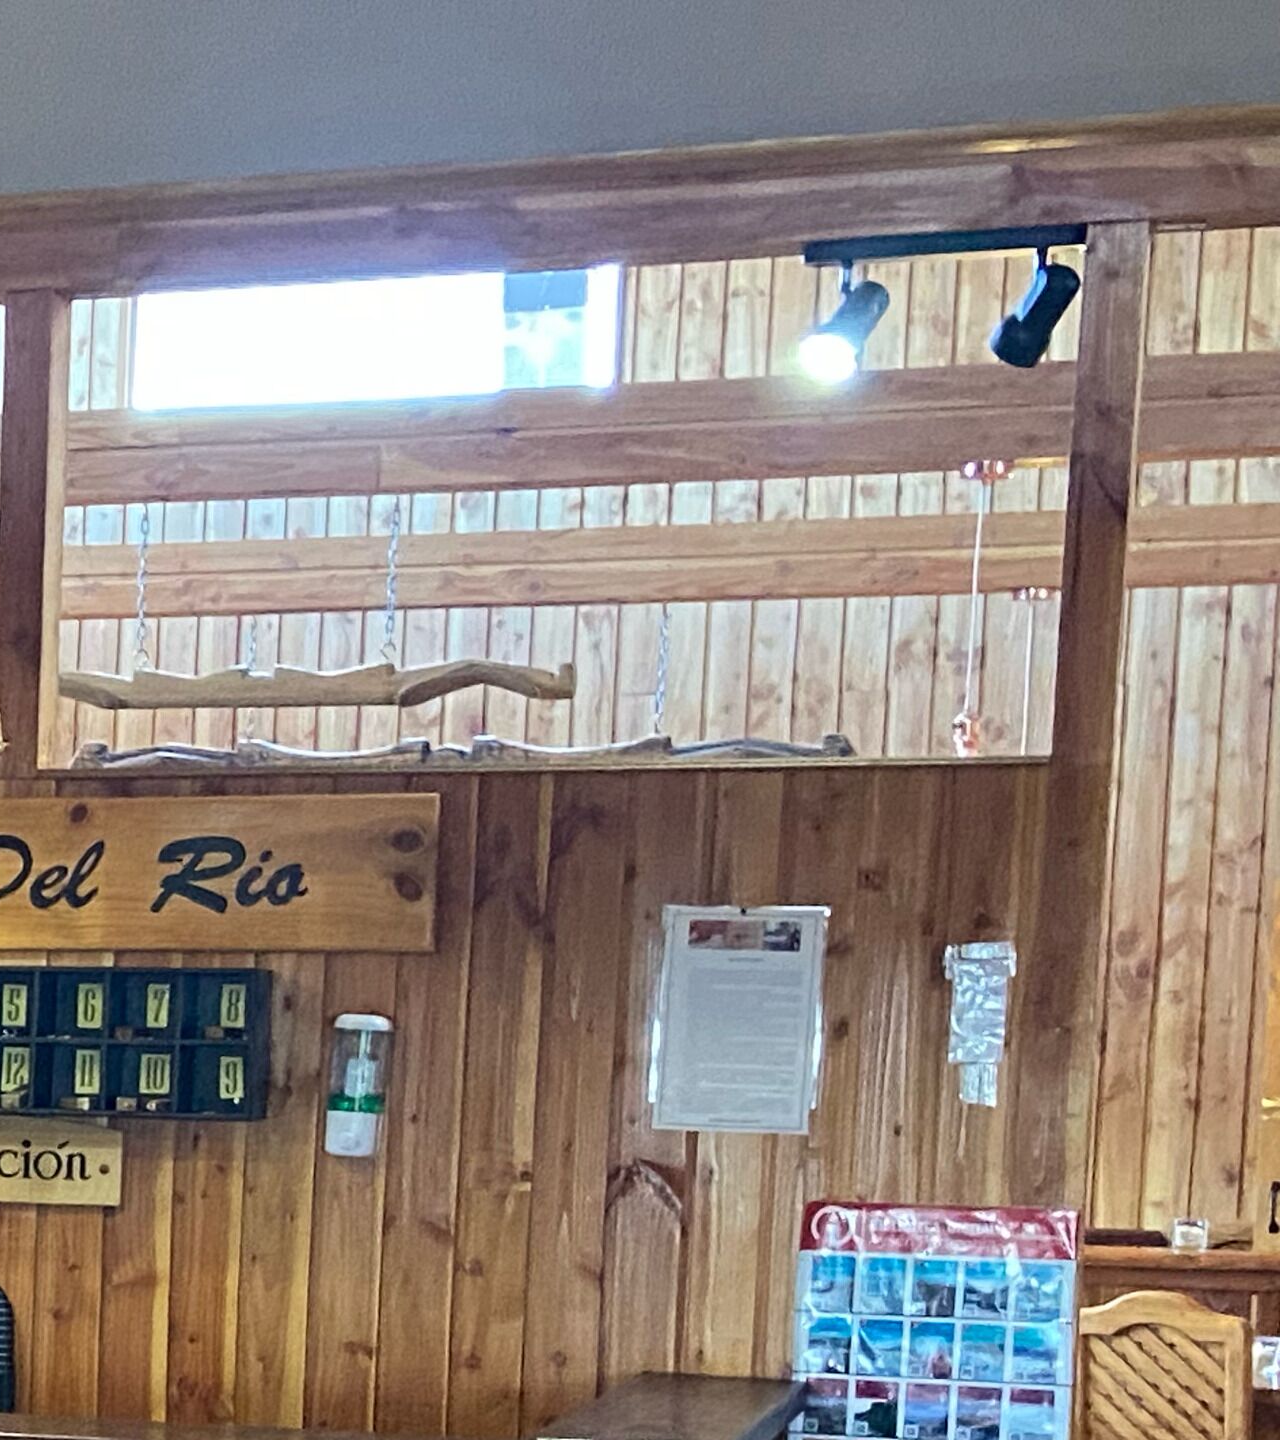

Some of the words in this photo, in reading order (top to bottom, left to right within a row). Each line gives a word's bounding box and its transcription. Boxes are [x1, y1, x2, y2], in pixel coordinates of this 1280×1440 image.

[150, 836, 308, 914] Rio
[6, 987, 21, 1022] 5
[83, 988, 96, 1023] 6
[154, 988, 167, 1023] 7
[226, 988, 240, 1022] 8
[5, 1052, 25, 1086] 12
[80, 1054, 95, 1087] 11
[146, 1056, 167, 1090] 10
[225, 1060, 239, 1095] 9
